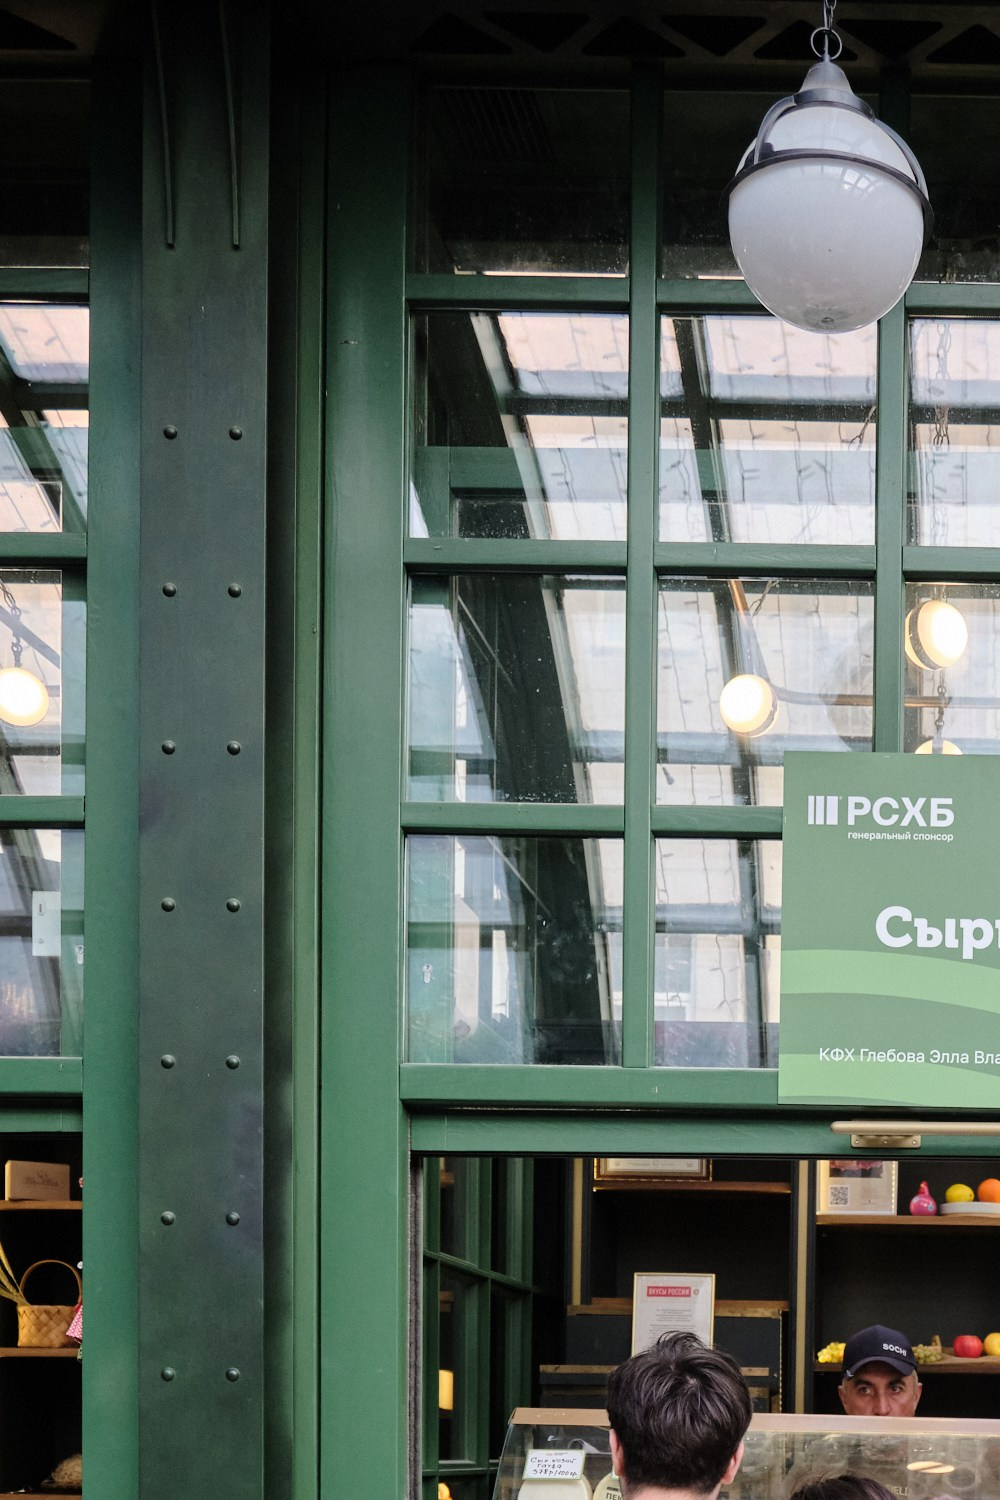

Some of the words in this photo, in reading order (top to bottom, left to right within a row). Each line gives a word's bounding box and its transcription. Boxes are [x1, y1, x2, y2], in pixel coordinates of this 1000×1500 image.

[847, 795, 955, 828] РСХБ
[847, 831, 912, 842] генеральный
[912, 833, 954, 843] спонсор
[819, 1047, 855, 1063] КФХ
[859, 1048, 925, 1063] Глебова
[929, 1049, 969, 1064] Элла
[668, 1287, 690, 1296] РОССИИ
[882, 1343, 907, 1357] SOCHI
